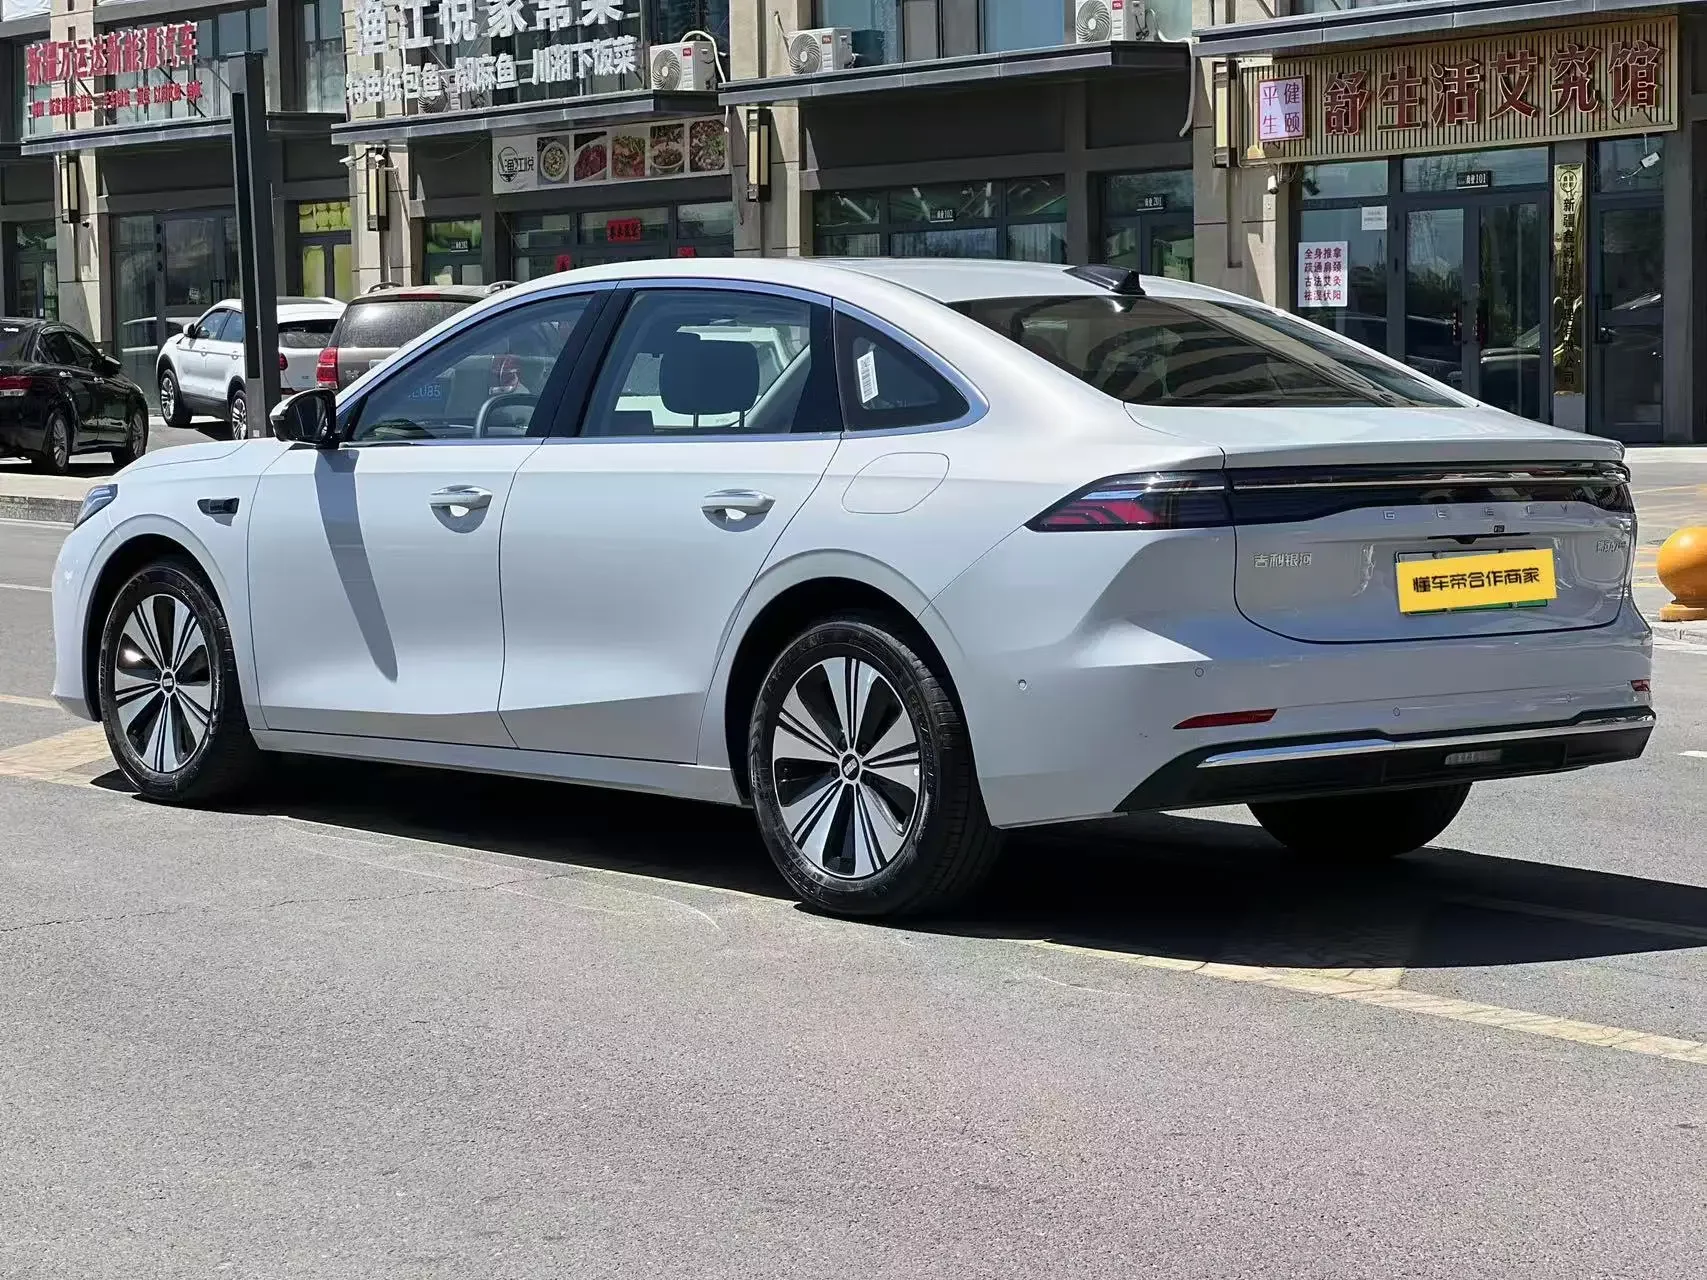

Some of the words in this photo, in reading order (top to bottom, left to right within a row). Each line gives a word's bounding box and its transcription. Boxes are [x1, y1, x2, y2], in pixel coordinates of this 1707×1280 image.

[532, 35, 638, 85] 川湘下饭菜
[1323, 40, 1660, 136] 舒生活艾究馆
[1304, 247, 1342, 260] 全身推拿
[1304, 261, 1342, 273] 疏通肩颈
[1304, 275, 1341, 287] 古法艾灸
[1254, 553, 1312, 568] 吉利银河
[1412, 567, 1541, 593] 懂车帝合作商家
